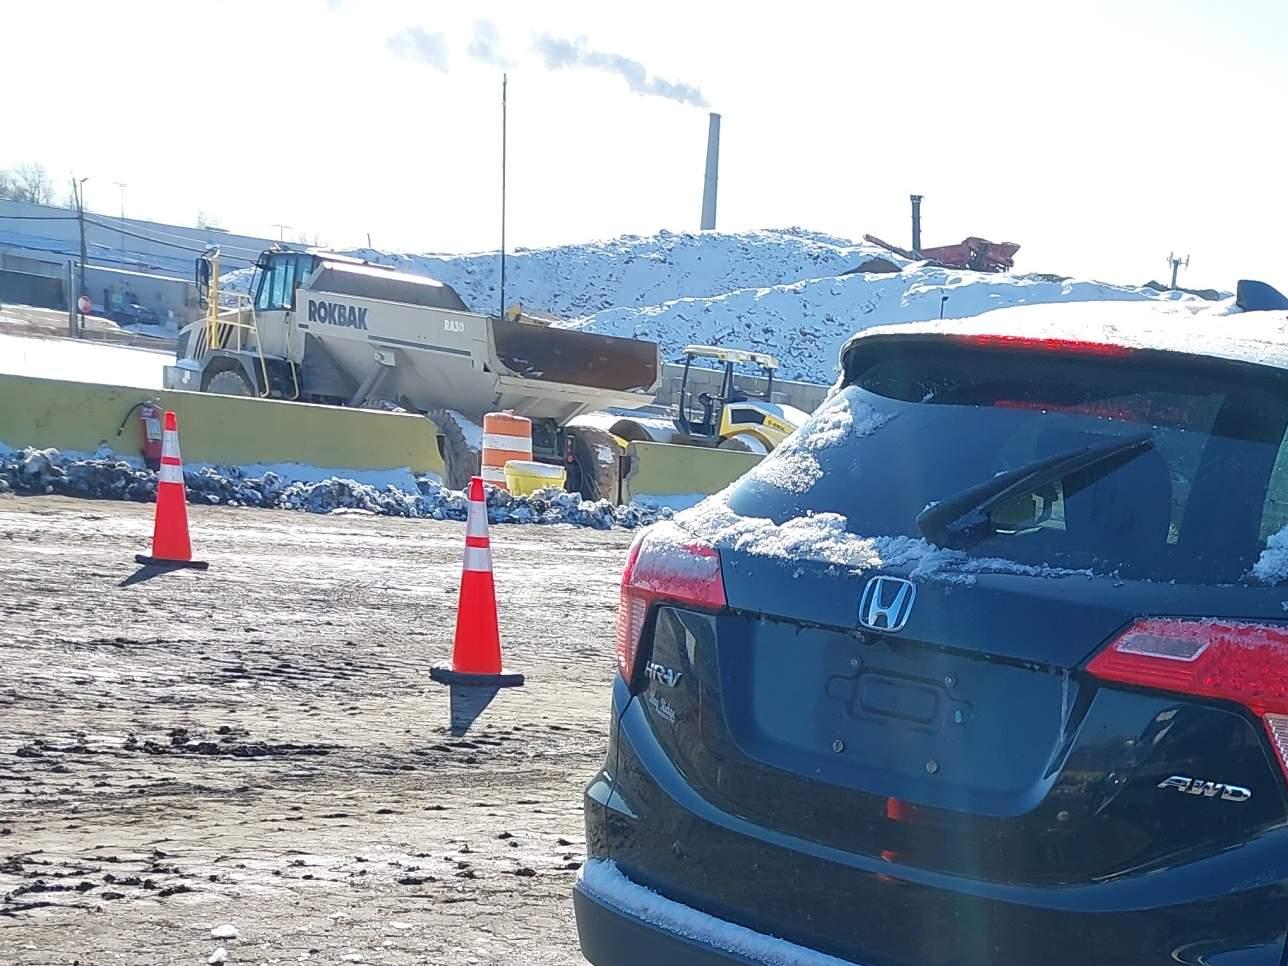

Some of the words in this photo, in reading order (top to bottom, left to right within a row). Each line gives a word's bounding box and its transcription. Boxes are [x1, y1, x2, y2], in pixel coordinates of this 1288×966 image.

[307, 299, 369, 331] ROKBAK
[443, 319, 465, 333] RA30
[1157, 775, 1252, 802] AWD
